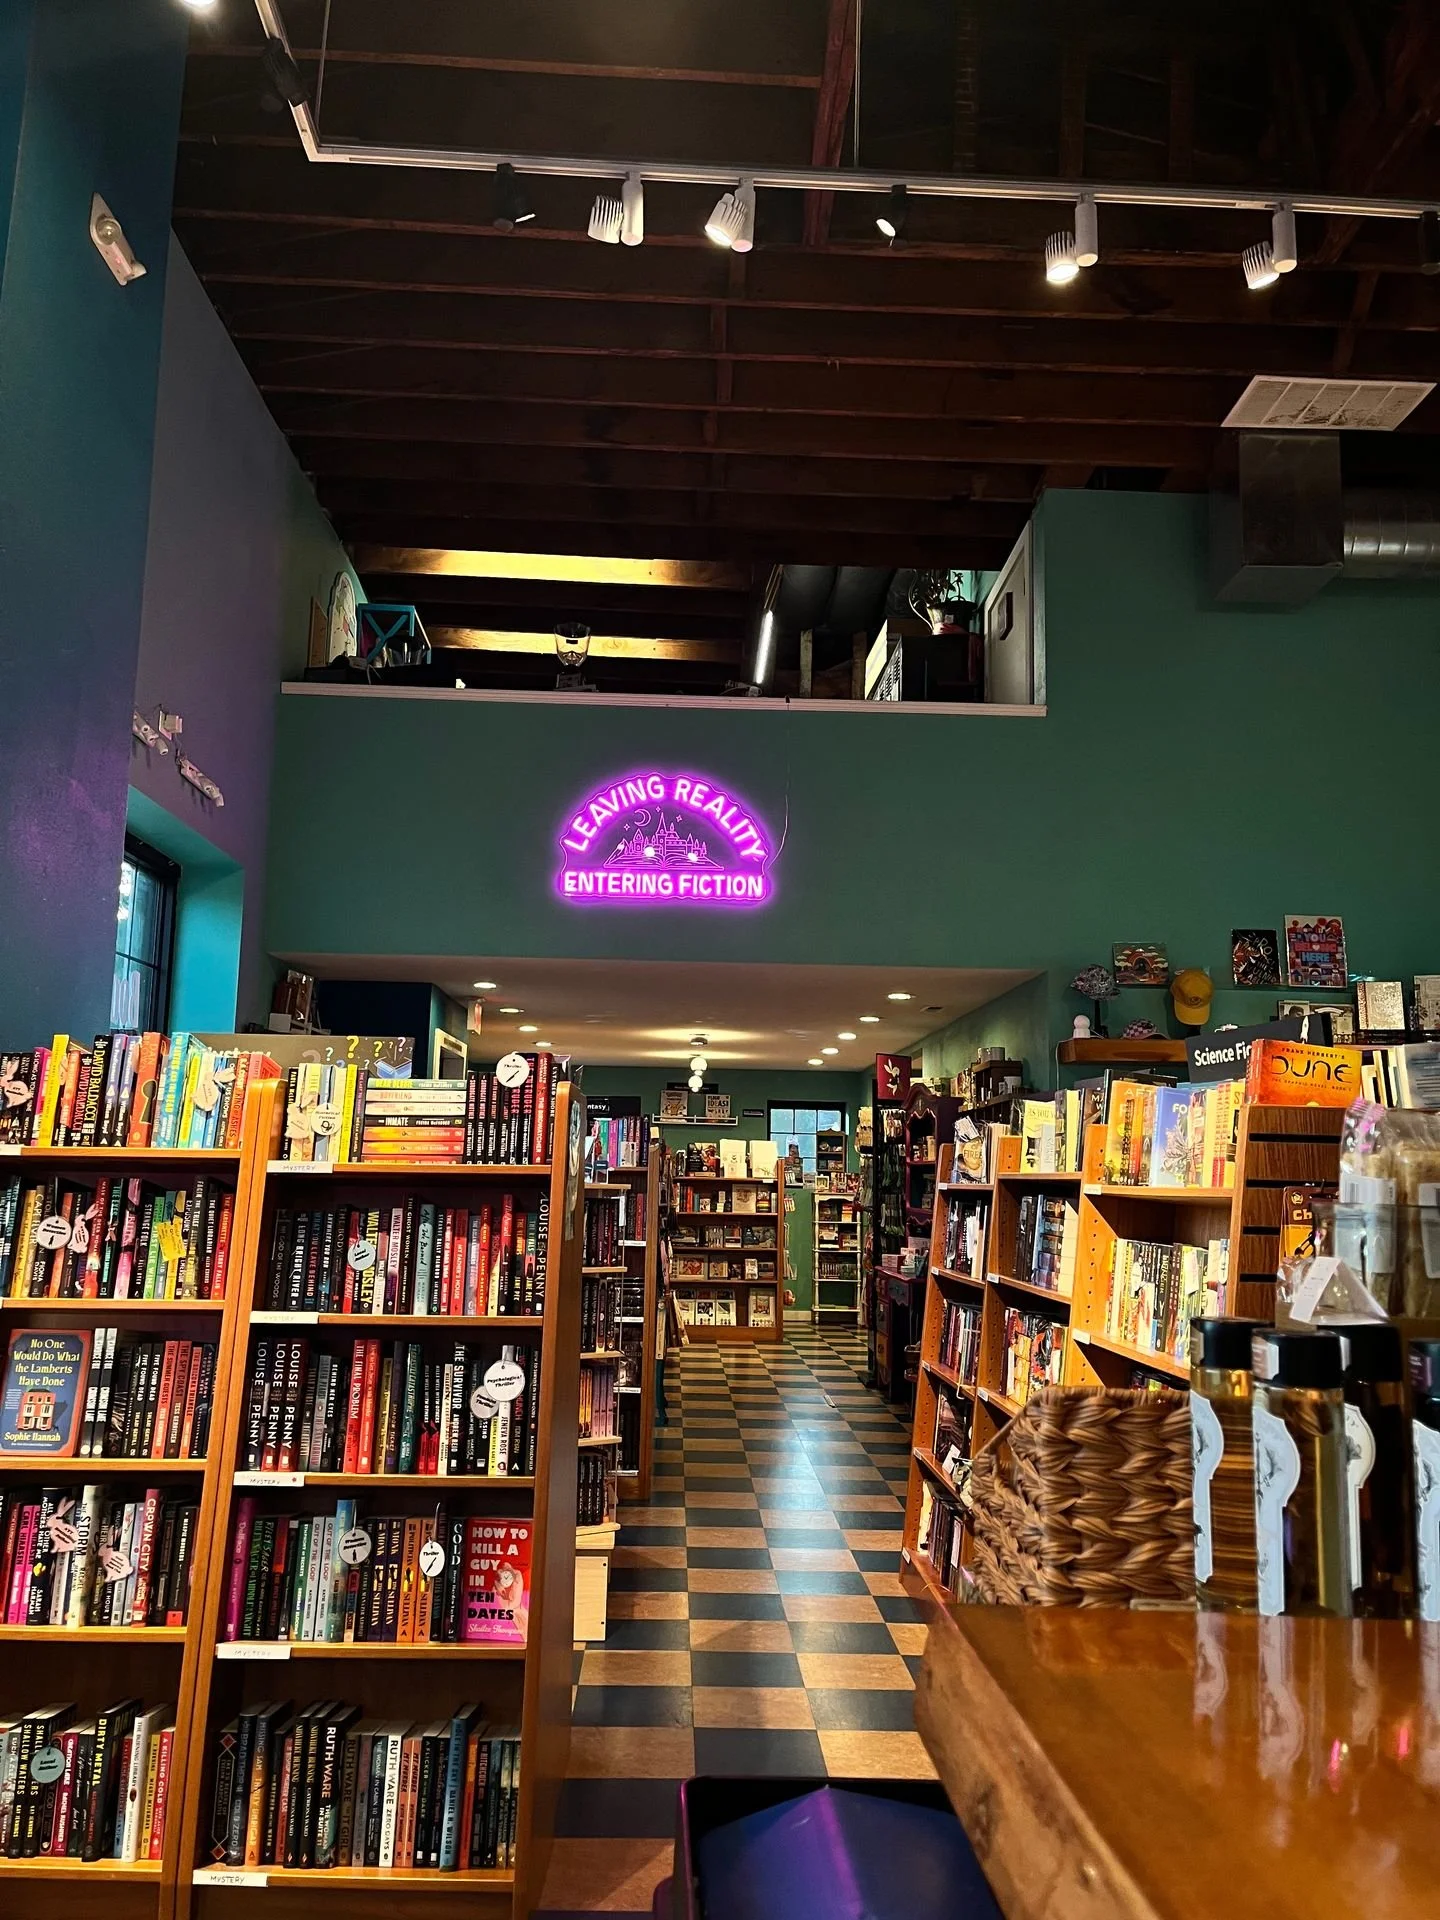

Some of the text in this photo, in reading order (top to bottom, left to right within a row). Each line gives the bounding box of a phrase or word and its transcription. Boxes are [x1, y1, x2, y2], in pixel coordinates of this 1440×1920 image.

[563, 776, 766, 858] LEAVING REALITY
[564, 872, 764, 897] ENTERING FICTION
[1302, 952, 1330, 962] HERE
[1194, 1046, 1234, 1067] Science
[1271, 1054, 1352, 1084] DUNE
[72, 1066, 91, 1130] DAVID BALDACCI
[85, 1050, 105, 1121] DAVID BALDACCI
[588, 1103, 606, 1112] ntasy
[140, 1204, 152, 1246] STRANGE FOLK
[389, 1214, 400, 1268] WALTER MOSLEY
[404, 1235, 412, 1259] WOMEN
[535, 1198, 549, 1298] LOUISE PENNY
[290, 1226, 306, 1298] LONG BRIGHT RIVER
[310, 1246, 318, 1268] LEAVE
[38, 1261, 46, 1282] FIONA
[306, 1270, 315, 1297] BEHIND
[14, 1350, 80, 1361] Would Do What
[30, 1338, 64, 1349] No One
[455, 1346, 464, 1362] THE
[16, 1364, 72, 1374] the Lamberts
[104, 1360, 112, 1369] FOX
[139, 1368, 147, 1386] FOUND
[151, 1368, 159, 1386] FOUND
[164, 1358, 173, 1382] SUMMER
[175, 1345, 188, 1397] THE SPY COAST
[330, 1364, 338, 1386] BEHIND
[19, 1376, 64, 1386] Have Done
[136, 1387, 145, 1401] DEAD
[161, 1383, 170, 1404] GUESTS
[248, 1342, 268, 1447] LOUISE PENNY
[350, 1345, 364, 1418] THE FINAL PROBLEM
[452, 1366, 464, 1409] SURVIVOR
[266, 1344, 286, 1449] LOUISE PENNY
[281, 1344, 302, 1449] LOUISE PENNY
[96, 1410, 108, 1422] LAKE
[452, 1414, 460, 1438] ANDREW
[4, 1432, 60, 1444] Sophie Hannah
[500, 1440, 508, 1454] ROSE
[40, 1496, 48, 1528] MOTHERS
[42, 1530, 50, 1553] OTHER
[76, 1516, 91, 1556] STORM
[140, 1498, 156, 1572] CROWN CITY
[452, 1523, 462, 1566] COLD
[472, 1527, 528, 1540] HOW TO
[471, 1544, 519, 1556] KILL A
[371, 1533, 386, 1626] MONK SULLIVAN
[386, 1531, 400, 1625] MONK SULLIVAN
[470, 1560, 499, 1571] GUY
[469, 1576, 484, 1587] IN
[28, 1586, 38, 1615] HARMAN
[35, 1590, 44, 1612] SARAH
[402, 1594, 410, 1626] SULLIVAN
[420, 1594, 428, 1626] SULLIVAN
[468, 1590, 495, 1603] TEN
[467, 1608, 514, 1620] DATES
[16, 1724, 32, 1795] SHALLOW WATERS
[92, 1719, 107, 1786] DIRTY METAL
[160, 1746, 168, 1778] KILLING
[322, 1726, 337, 1798] RUTH WARE
[388, 1740, 399, 1770] RUTH
[400, 1752, 410, 1793] MY MURDER
[410, 1752, 420, 1793] MY MURDER
[342, 1740, 357, 1850] RUTH WARE IT GIRL
[386, 1773, 396, 1805] WARE
[322, 1820, 330, 1849] WOMAN
[210, 1875, 246, 1884] MYSTERY
